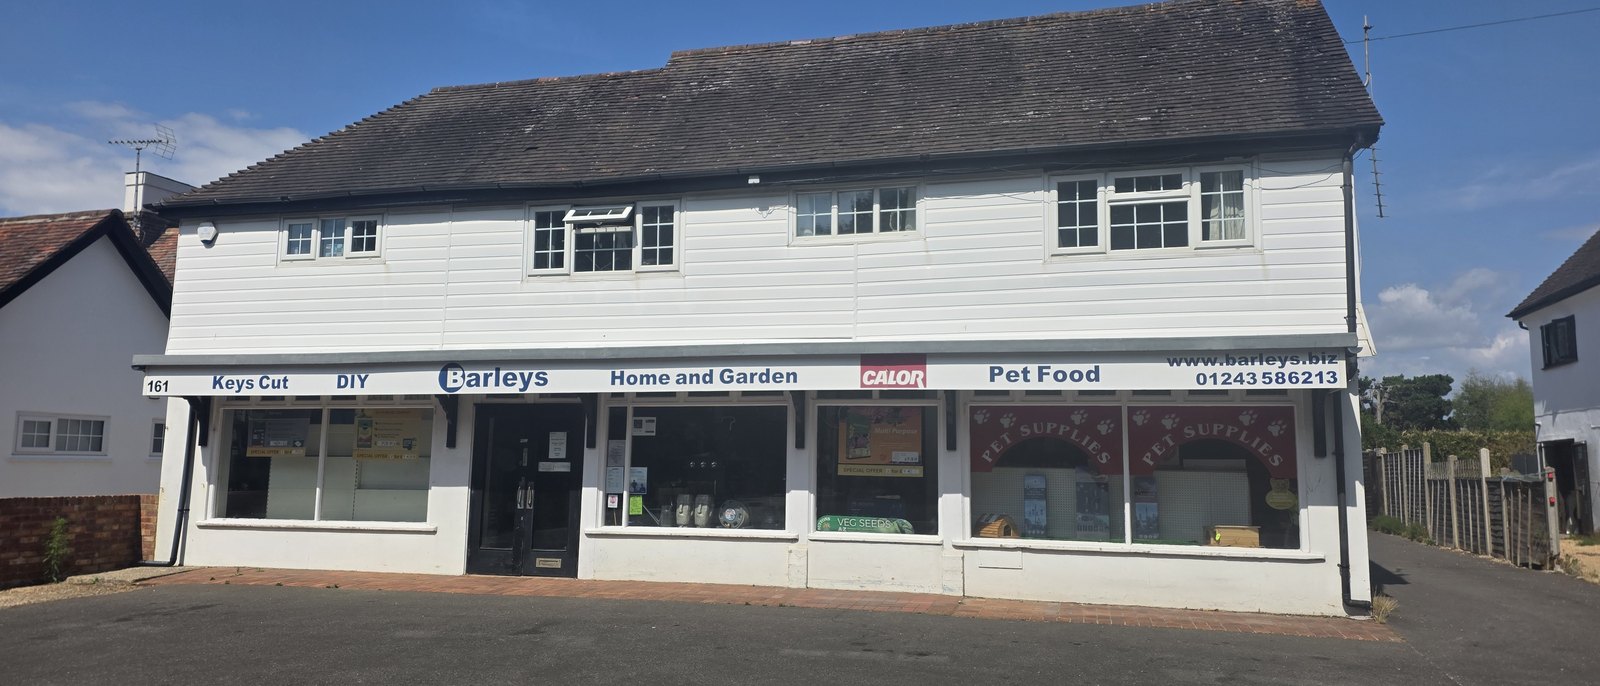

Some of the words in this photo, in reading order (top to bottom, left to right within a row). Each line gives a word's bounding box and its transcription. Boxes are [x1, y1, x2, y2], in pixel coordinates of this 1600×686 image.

[1167, 352, 1338, 369] www.barleys.biz
[336, 374, 369, 389] DIY
[438, 362, 549, 393] Barleys
[610, 370, 670, 386] Home
[675, 369, 714, 385] and
[719, 368, 798, 385] Garden
[862, 370, 925, 389] CALOR
[989, 366, 1031, 383] Pet
[1037, 365, 1101, 383] Food
[1196, 372, 1257, 386] 01243
[1261, 371, 1338, 385] 586213
[147, 380, 169, 393] 161
[212, 375, 254, 393] Keys
[258, 375, 289, 390] Cut
[981, 432, 1012, 463] PET
[1019, 422, 1111, 465] SUPPLIES
[1142, 433, 1175, 467] PET
[1183, 423, 1283, 467] SUPPLIES
[837, 518, 857, 527] VEG
[859, 519, 891, 528] SEEDS
